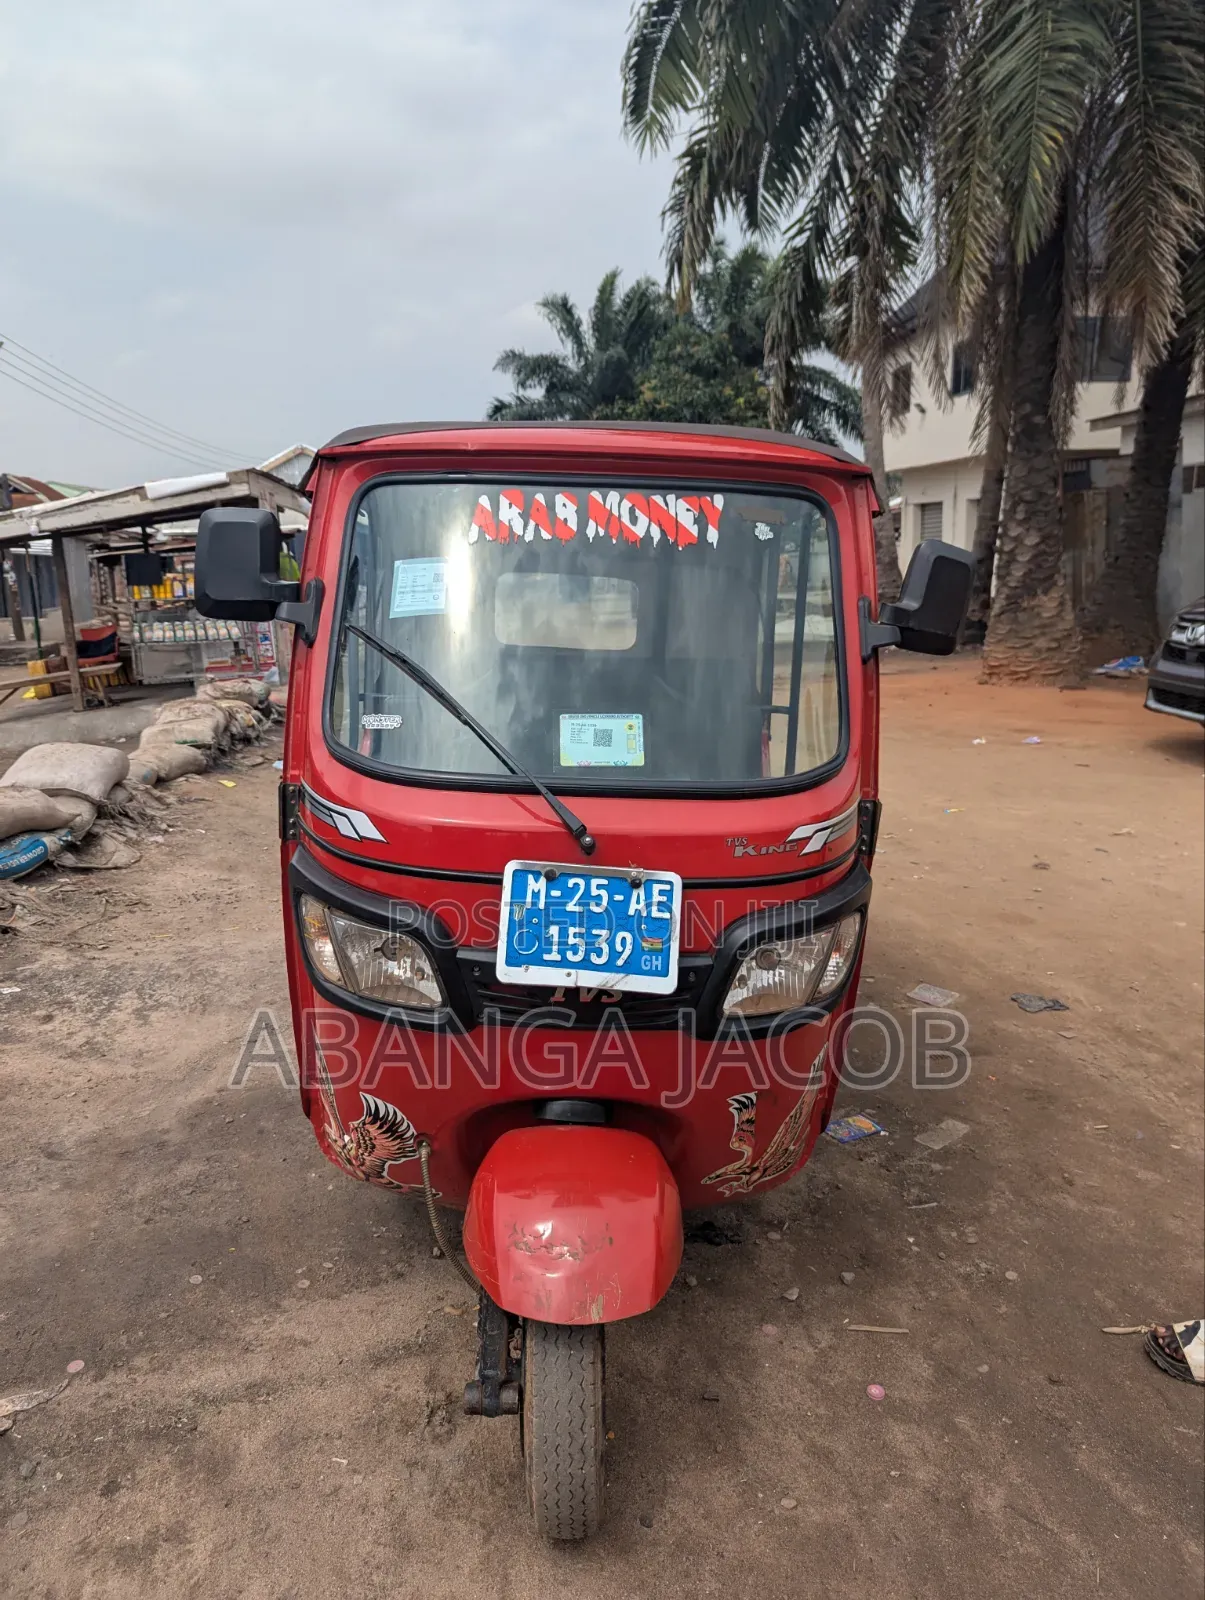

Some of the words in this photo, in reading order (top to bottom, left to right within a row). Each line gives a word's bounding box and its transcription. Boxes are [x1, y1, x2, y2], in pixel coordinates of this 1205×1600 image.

[468, 489, 578, 546] ARAB
[586, 491, 724, 550] MONEY
[726, 837, 748, 846] TVS
[733, 843, 798, 857] KING
[525, 874, 672, 919] M-25-AE
[543, 925, 634, 967] 1539
[640, 955, 662, 971] GH
